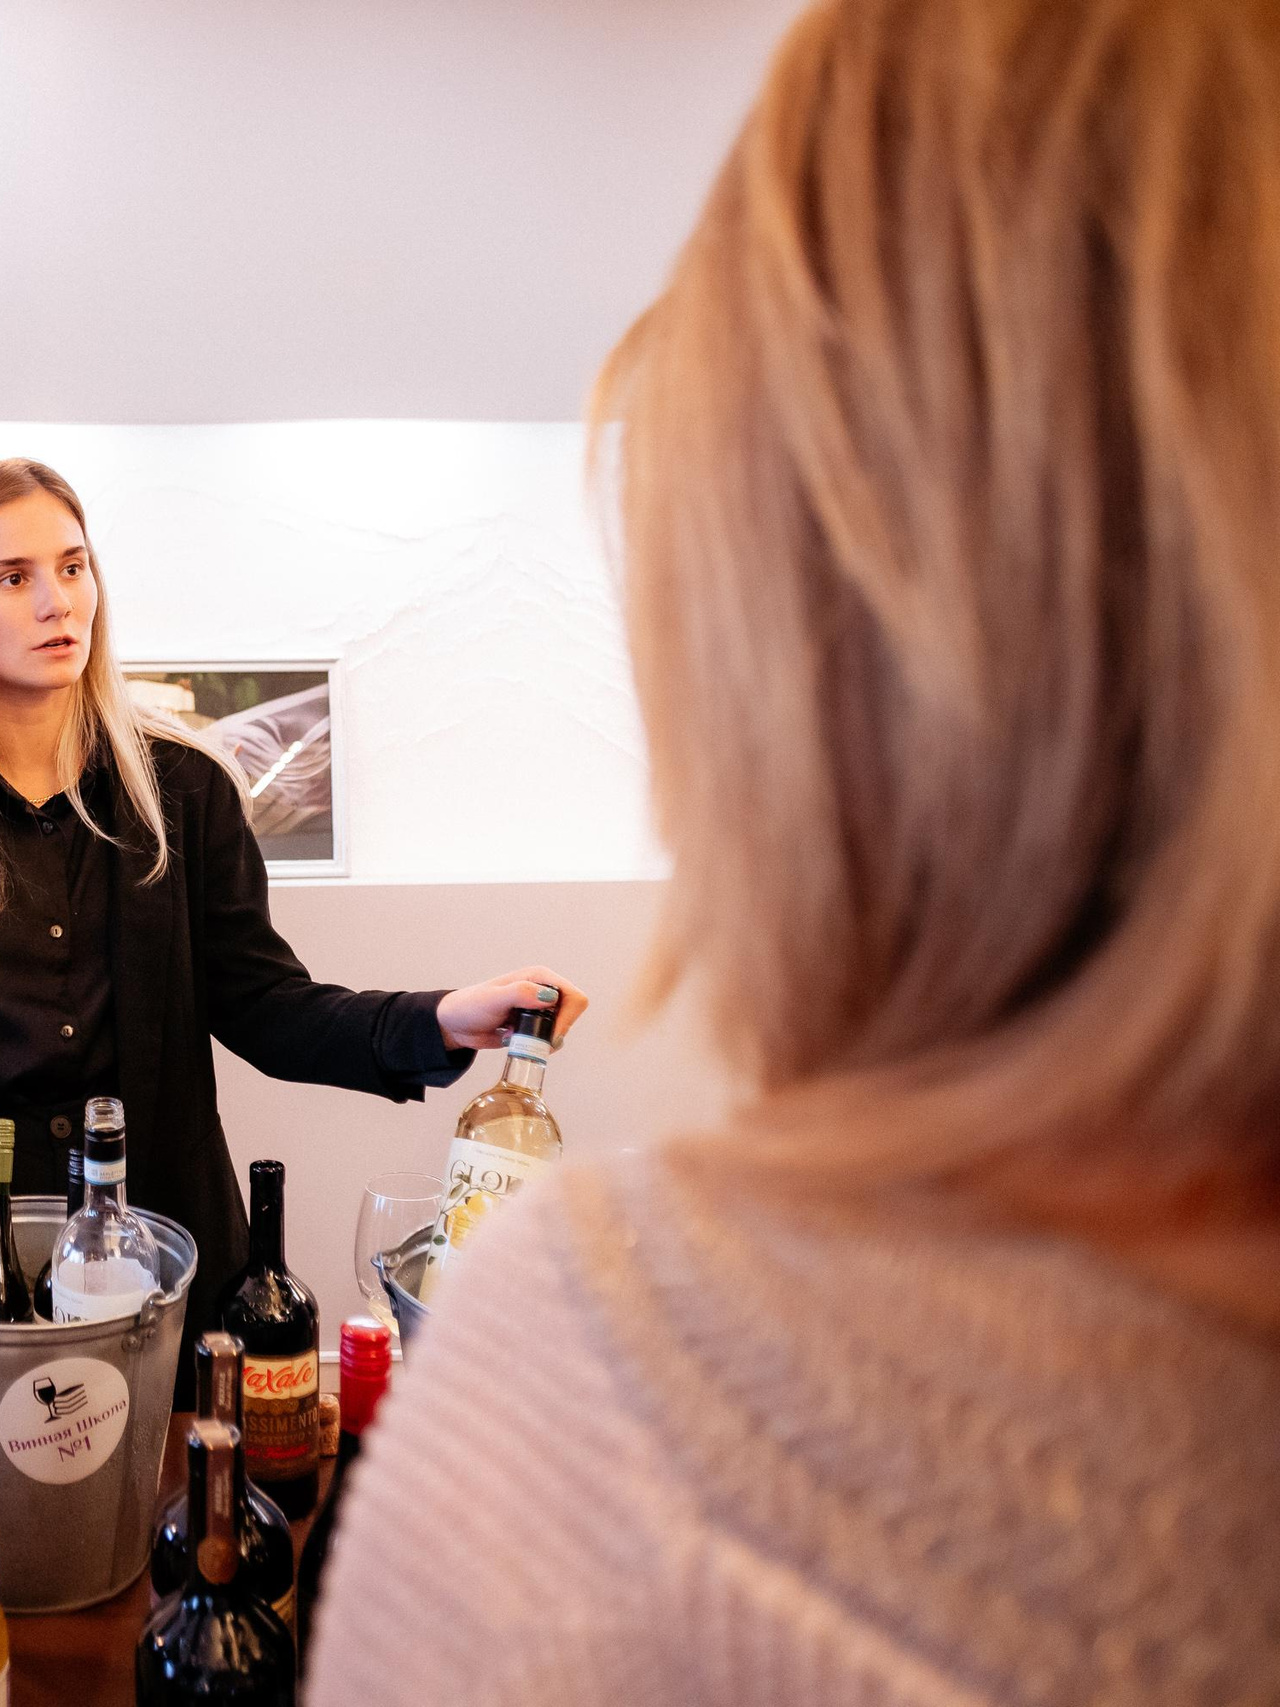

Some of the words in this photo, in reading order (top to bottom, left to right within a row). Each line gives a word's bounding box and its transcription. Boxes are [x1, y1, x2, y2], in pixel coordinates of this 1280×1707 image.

[8, 1428, 72, 1453] Винная
[76, 1400, 127, 1433] Школа
[244, 1406, 318, 1432] SSIMENTO
[58, 1435, 91, 1462] №1
